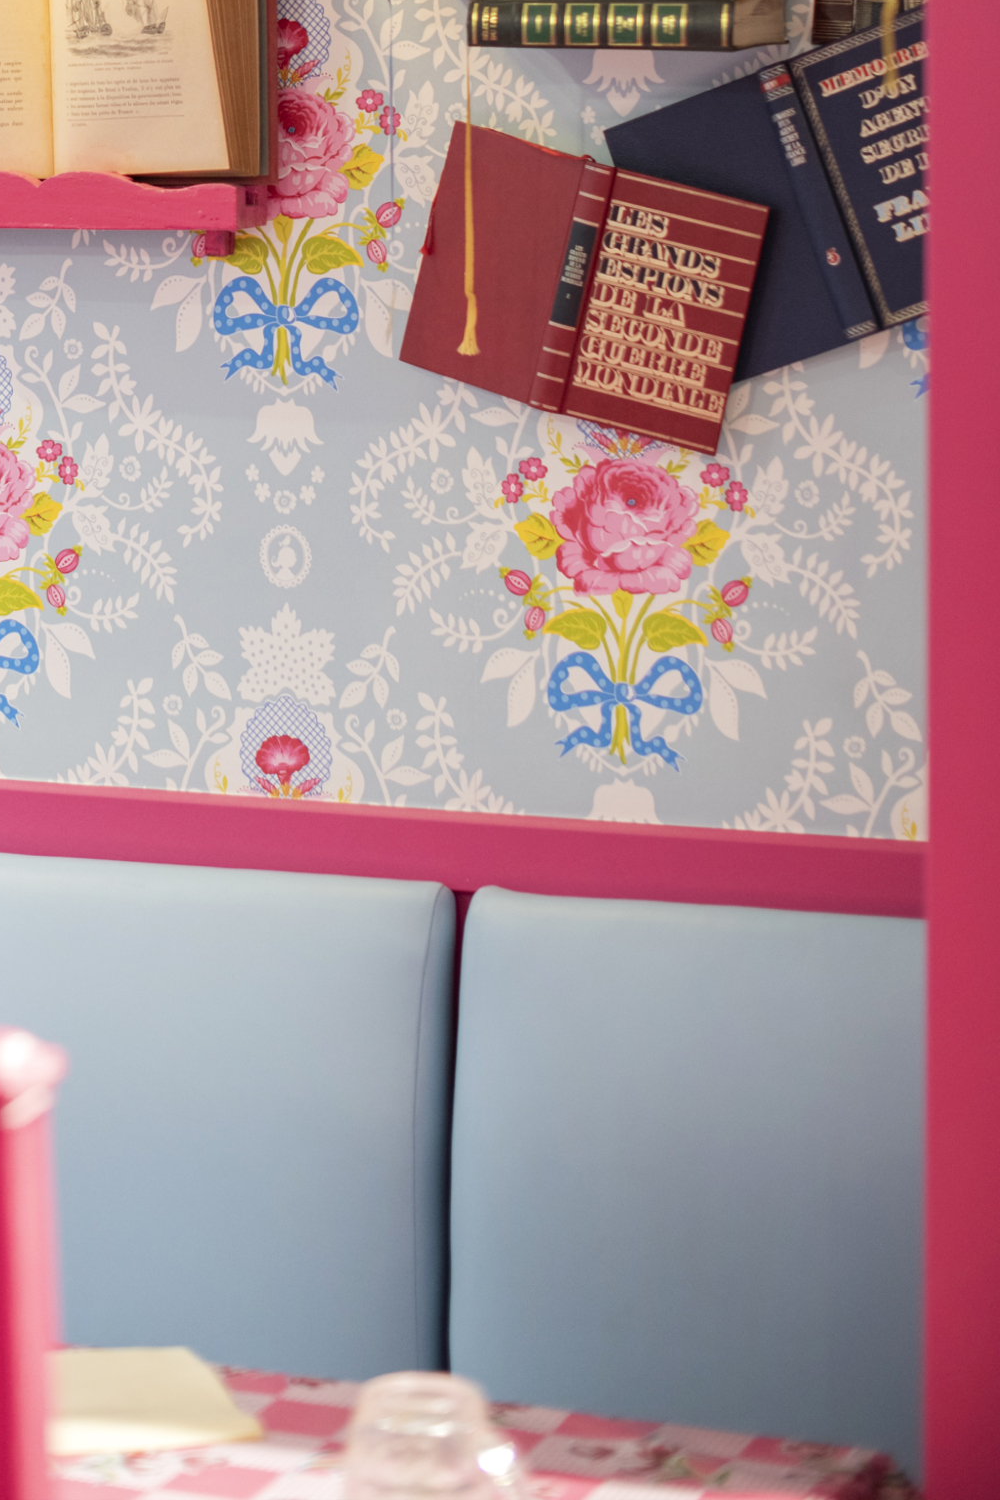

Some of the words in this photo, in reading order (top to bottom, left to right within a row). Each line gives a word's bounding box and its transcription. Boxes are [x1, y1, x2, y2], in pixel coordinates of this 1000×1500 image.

[818, 41, 930, 98] MEMOIRE
[858, 74, 917, 109] D'UN
[878, 158, 916, 185] DE
[606, 202, 670, 239] LES
[602, 231, 721, 279] GRANDS
[590, 281, 638, 315] DE
[643, 295, 686, 328] LA
[596, 256, 726, 308] ESPIONS
[580, 334, 707, 388] GUERRE
[584, 308, 724, 365] SECONDE
[573, 359, 726, 421] MONDIALE
